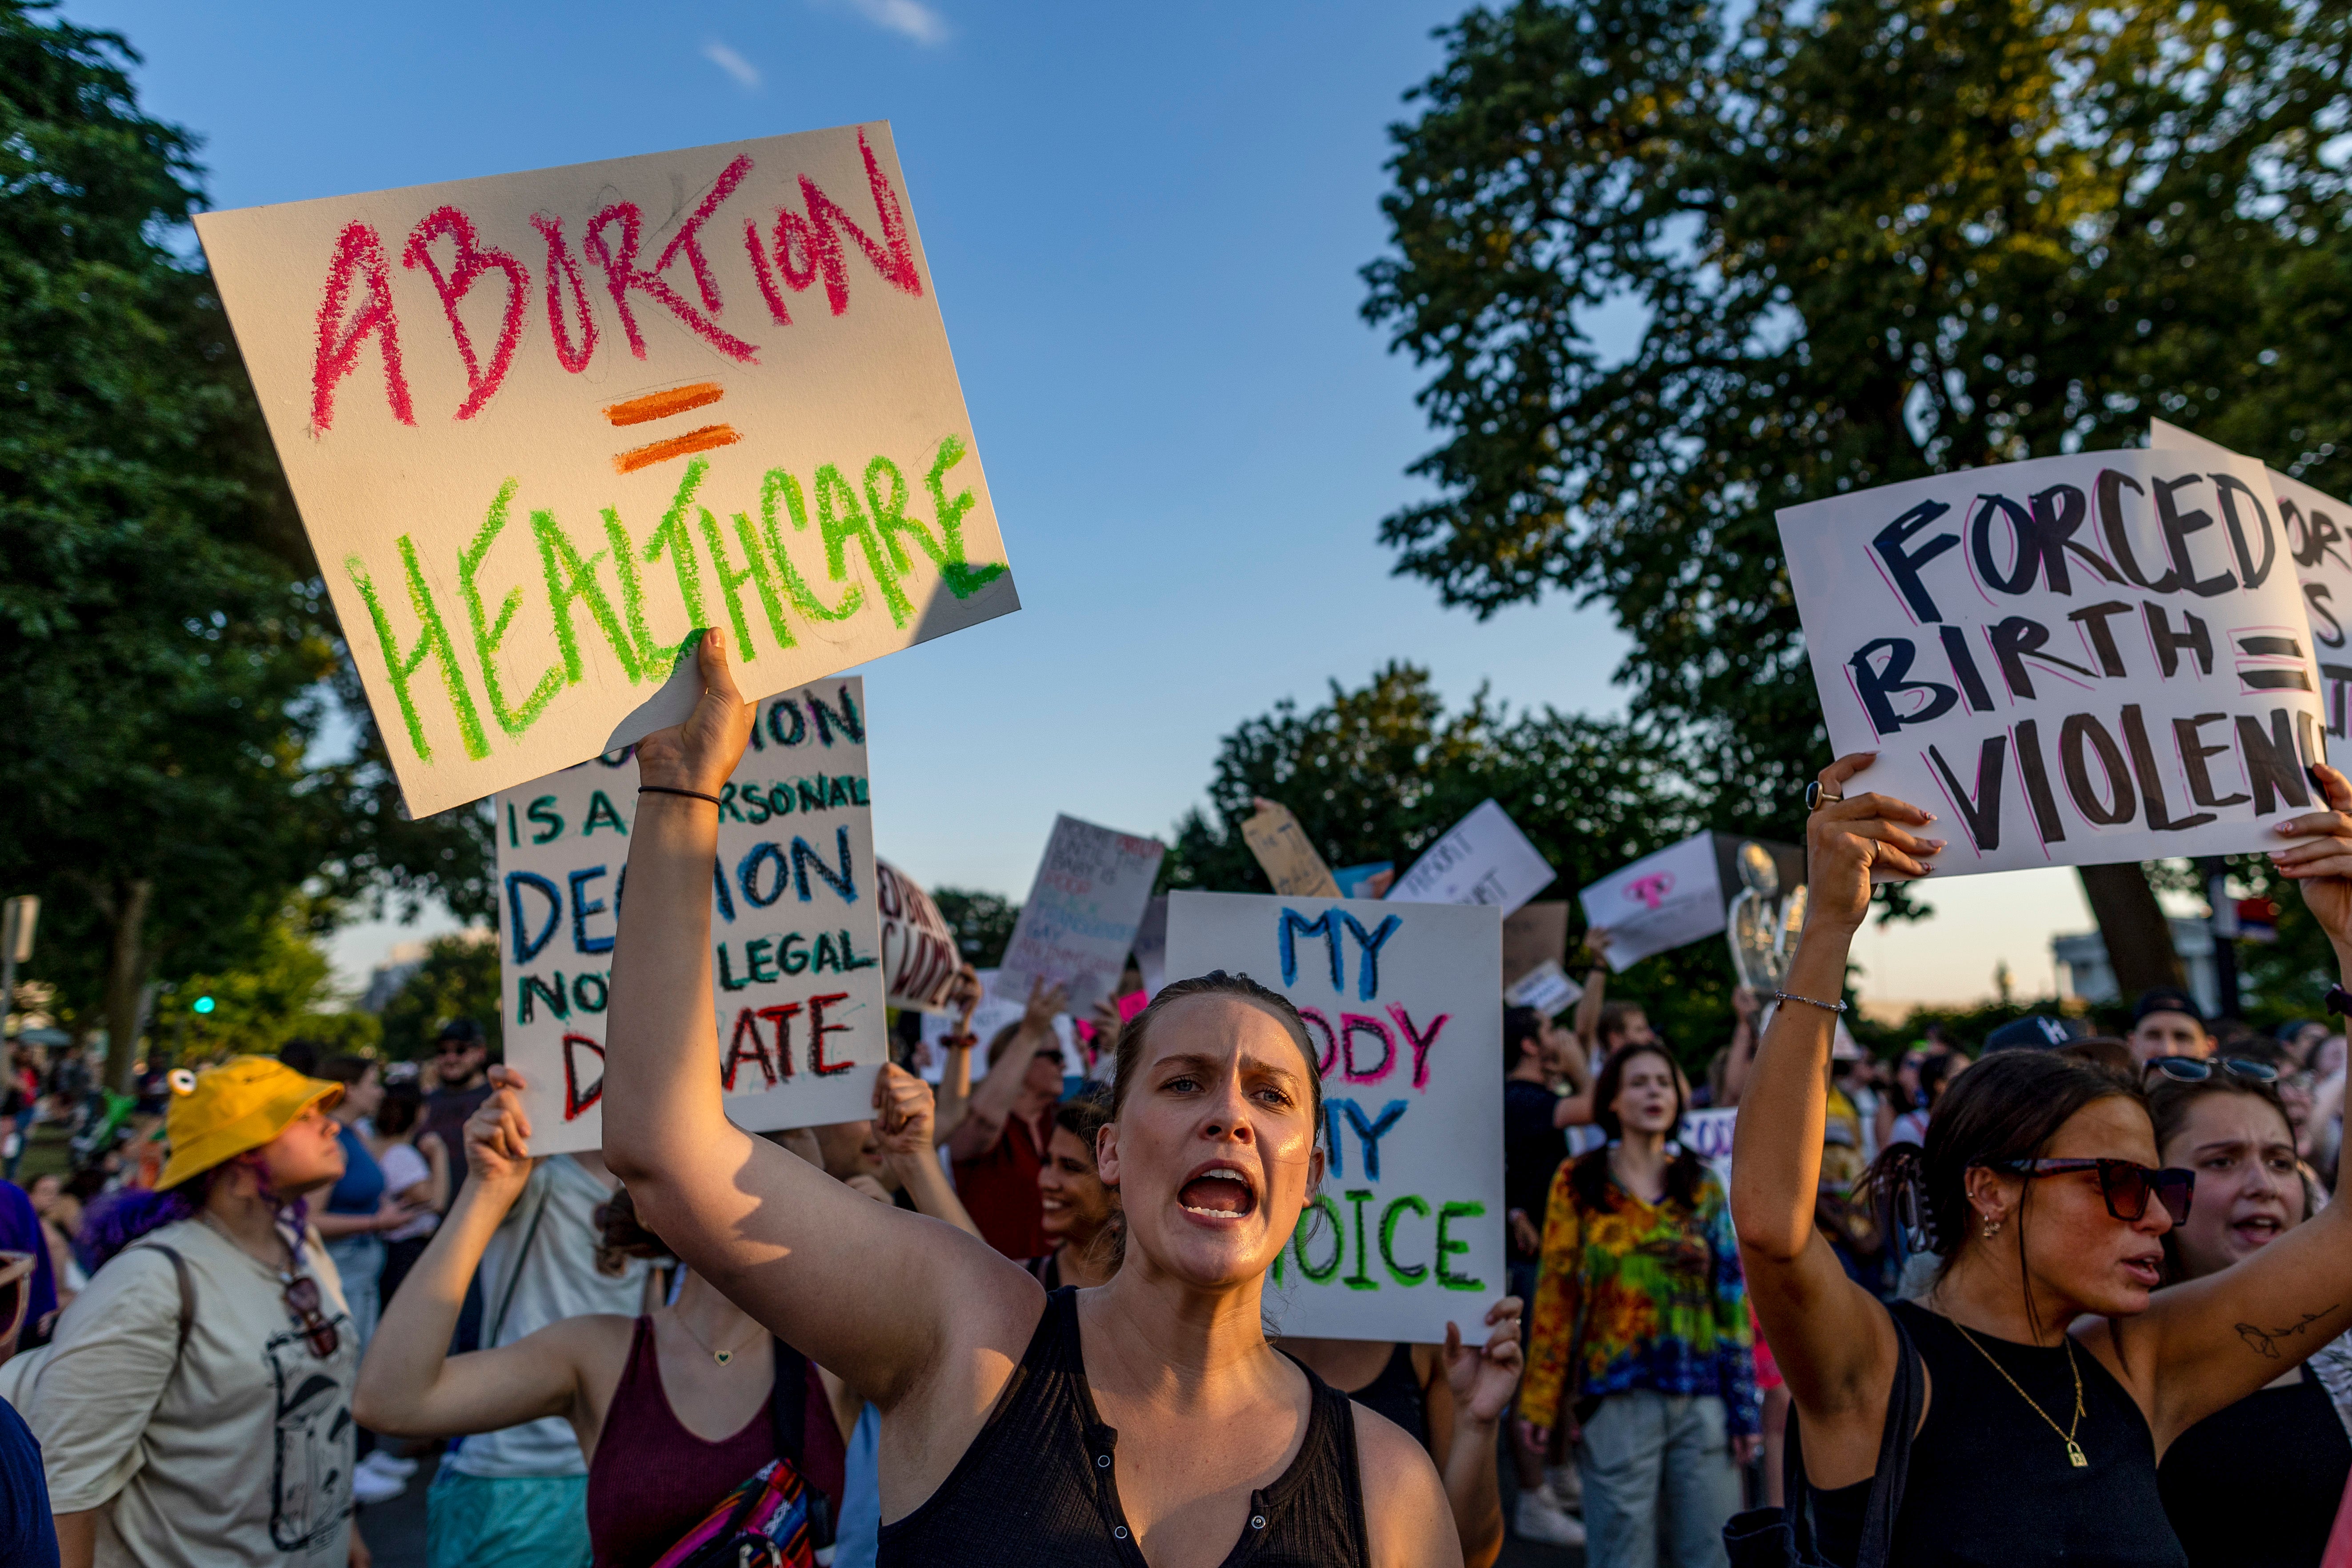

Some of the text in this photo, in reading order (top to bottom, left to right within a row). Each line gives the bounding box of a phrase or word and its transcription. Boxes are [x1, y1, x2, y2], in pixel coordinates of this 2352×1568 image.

[310, 125, 923, 438] ABORTION
[344, 434, 1010, 764] HEALTHCARE
[1867, 468, 2276, 624] FORCED
[1847, 600, 2213, 736] BIRTH
[508, 770, 871, 848] IS A RSONAL
[1927, 704, 2328, 852] VIOLEN
[504, 824, 859, 965] DEION
[1278, 906, 1403, 1001] MY
[517, 969, 610, 1026] NO
[718, 929, 879, 991] LEGAL
[562, 992, 855, 1122] DATE
[1297, 1001, 1452, 1095] ODY
[1271, 1189, 1486, 1291] OICE
